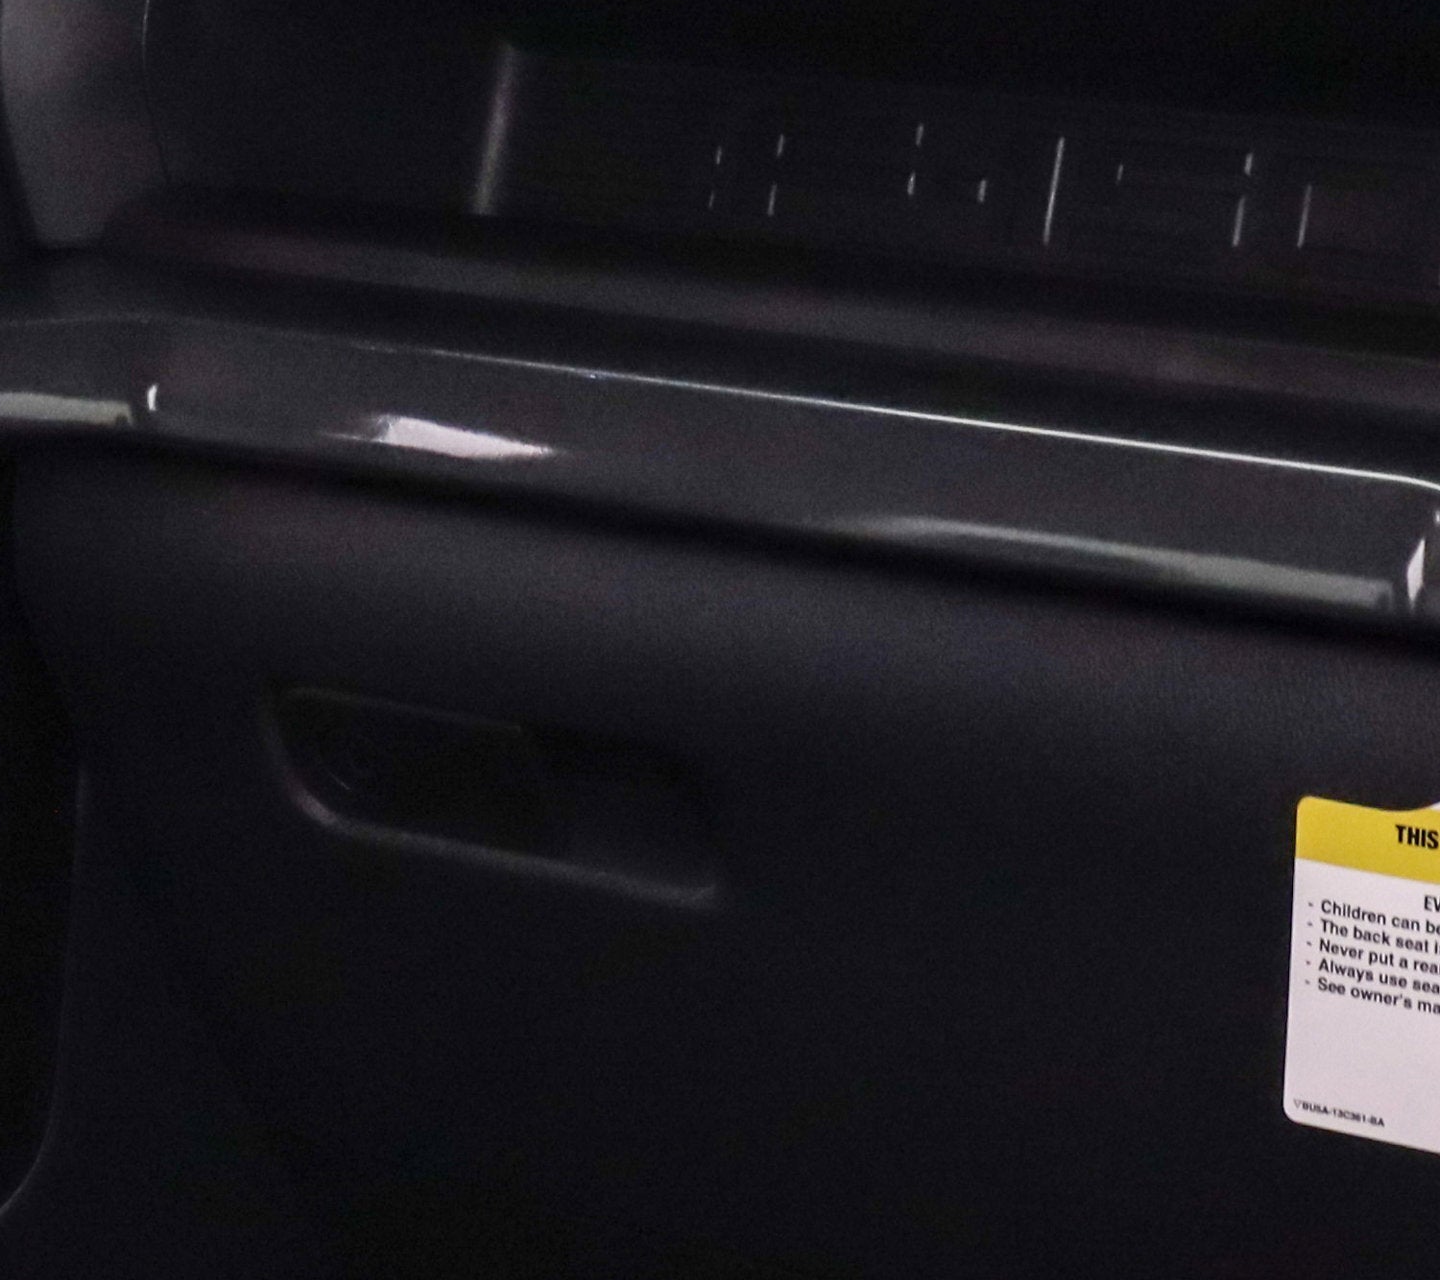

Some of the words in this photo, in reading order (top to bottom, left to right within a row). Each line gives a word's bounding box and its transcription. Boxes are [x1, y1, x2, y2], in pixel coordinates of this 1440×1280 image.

[1395, 824, 1439, 851] THIS
[1321, 900, 1387, 926] Children
[1392, 917, 1421, 932] can
[1321, 918, 1349, 939] The
[1353, 925, 1391, 947] back
[1396, 938, 1429, 954] seat
[1320, 938, 1364, 960] Never
[1368, 952, 1395, 973] put
[1399, 958, 1409, 969] a
[1318, 958, 1374, 983] Always
[1379, 973, 1408, 989] use
[1318, 977, 1346, 995] See
[1350, 987, 1413, 1009] owner's
